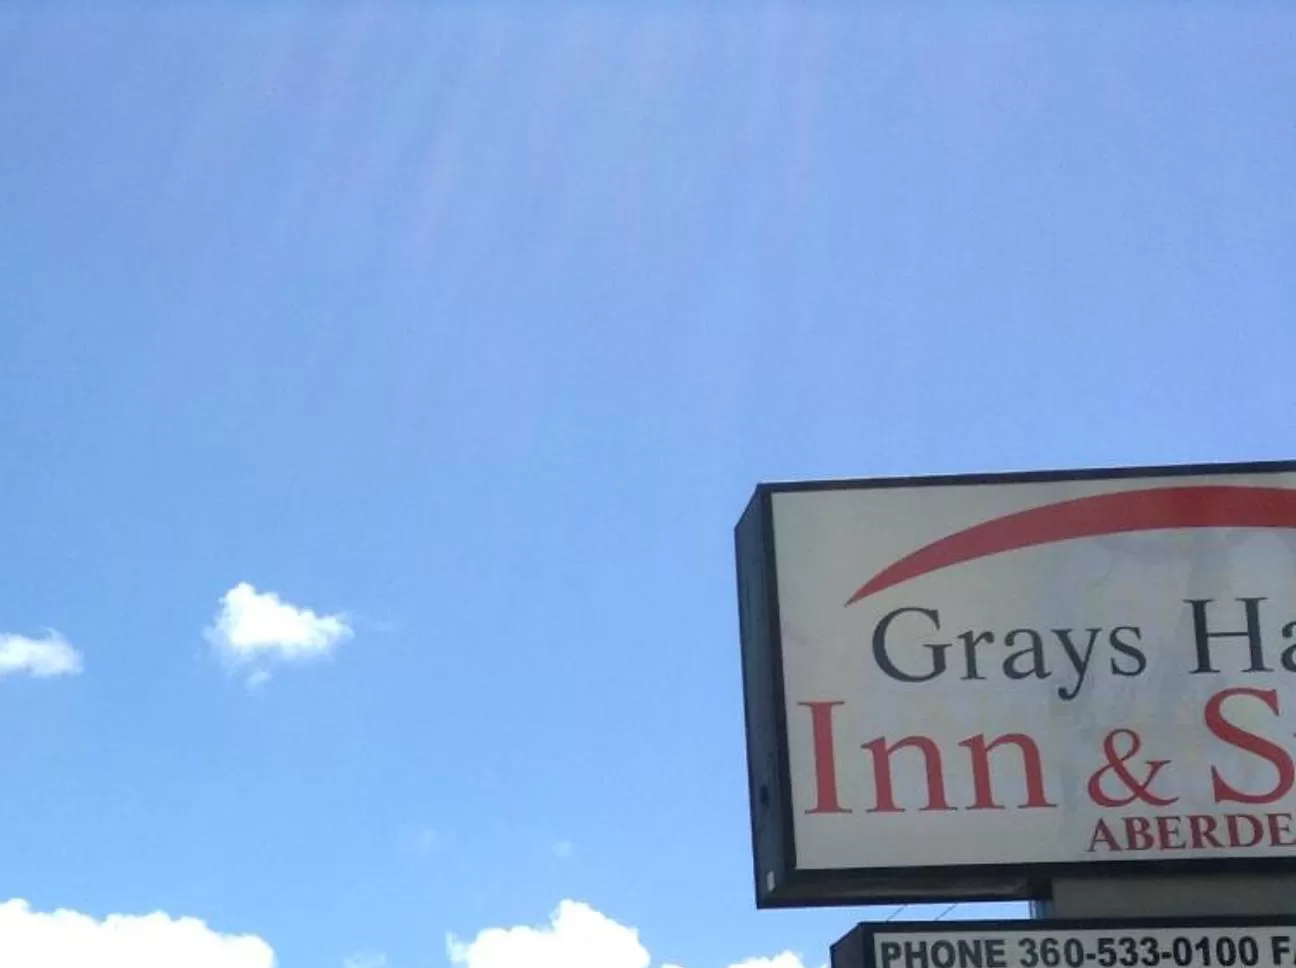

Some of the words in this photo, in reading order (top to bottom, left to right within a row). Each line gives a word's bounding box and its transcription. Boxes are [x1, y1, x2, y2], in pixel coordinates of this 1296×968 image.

[871, 606, 1147, 701] Grays
[798, 700, 1057, 814] Inn
[1087, 727, 1180, 809] &
[1203, 686, 1296, 806] S
[1087, 812, 1296, 854] ABERDE
[1019, 936, 1259, 968] 360-533-0100
[1270, 936, 1296, 967] F
